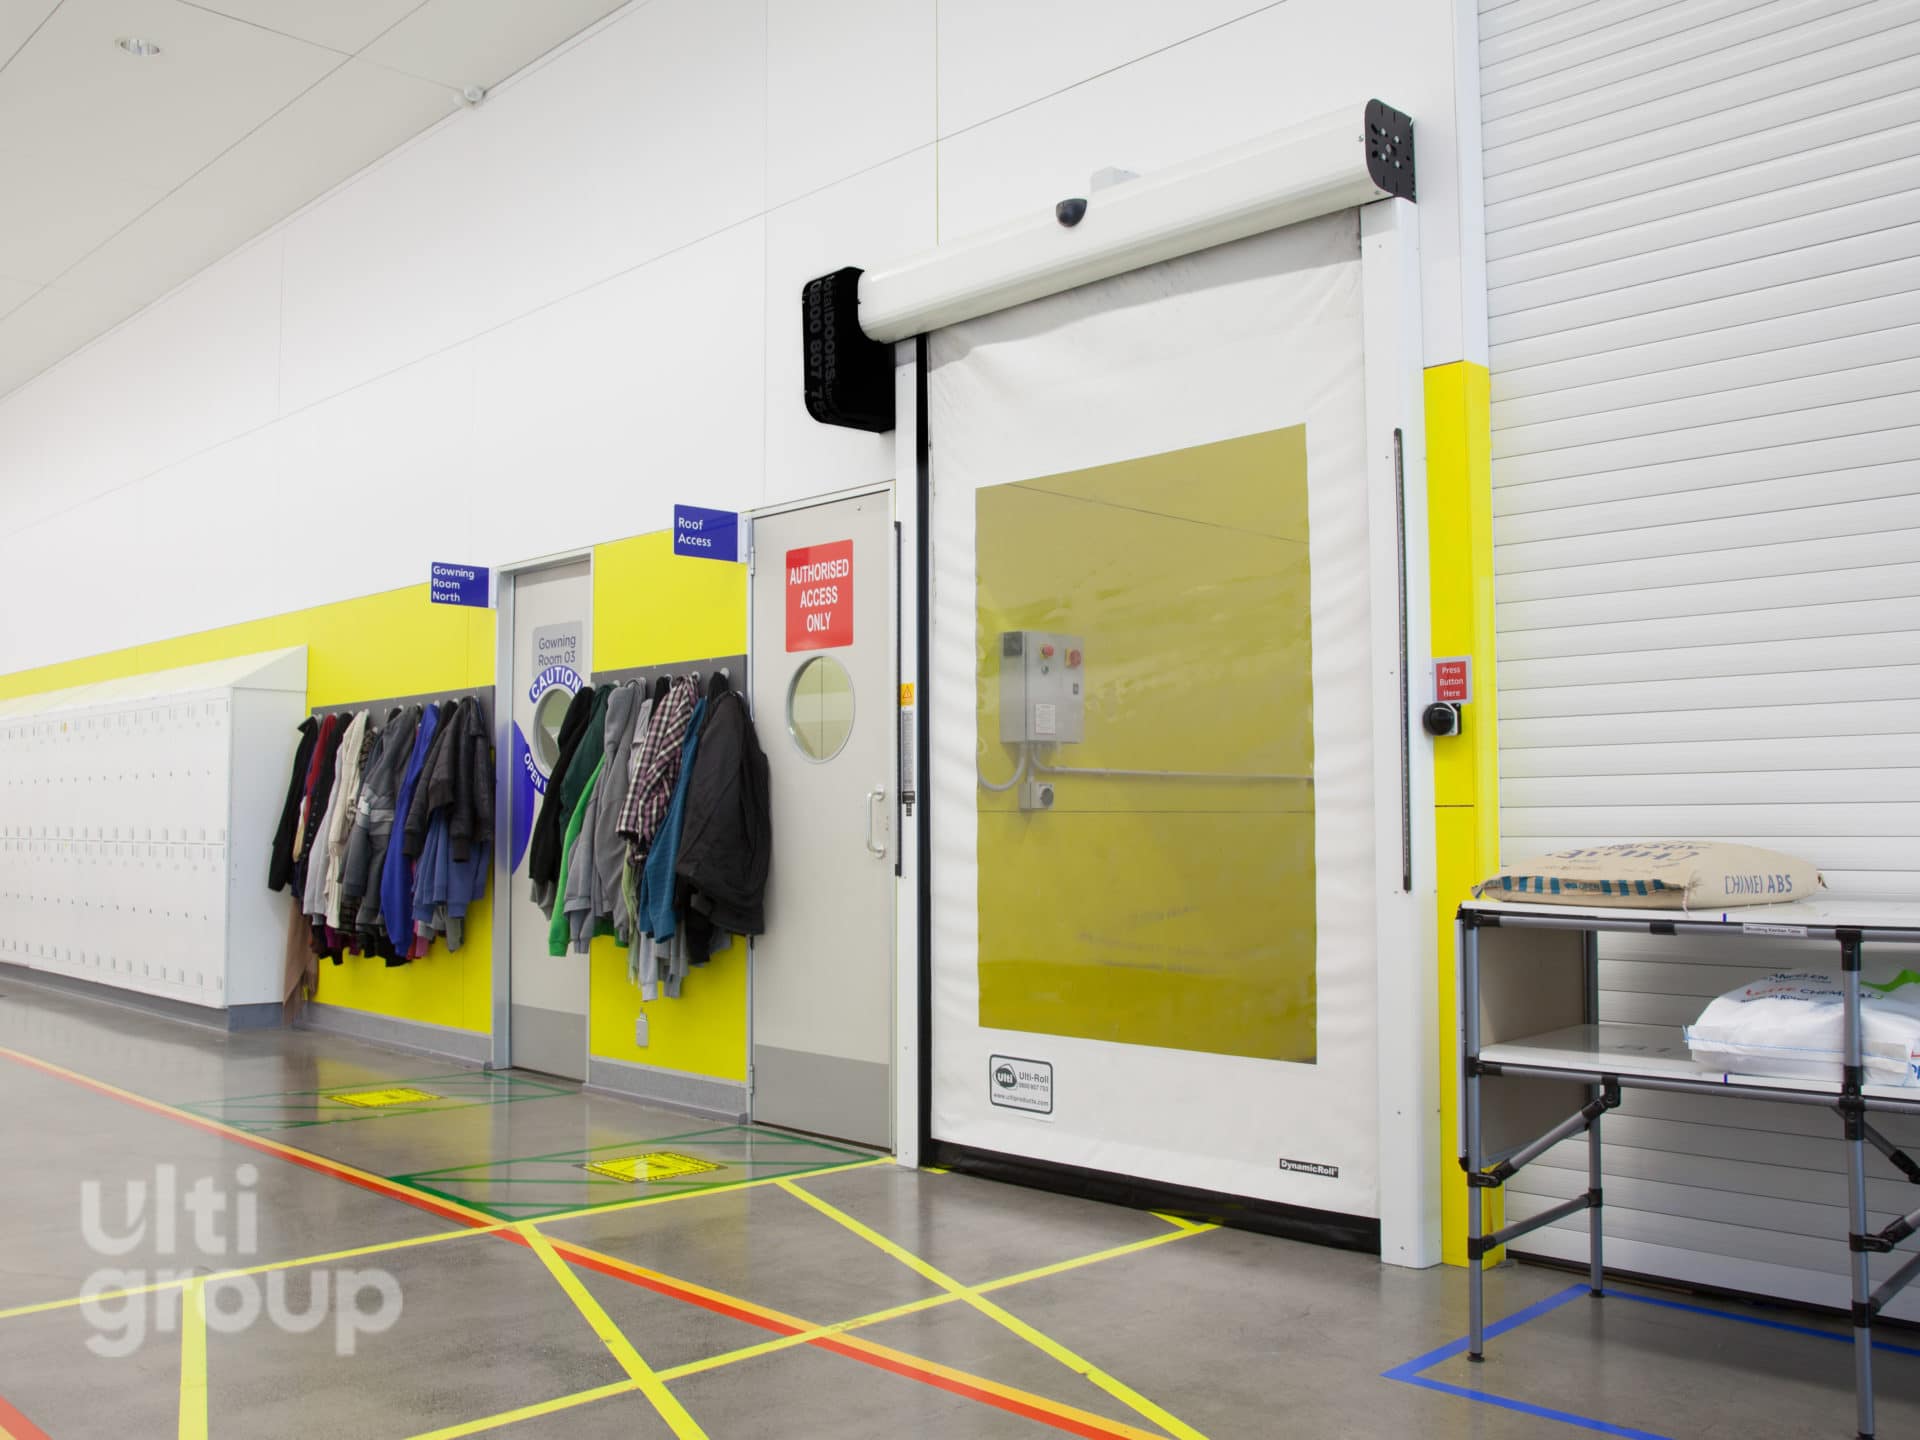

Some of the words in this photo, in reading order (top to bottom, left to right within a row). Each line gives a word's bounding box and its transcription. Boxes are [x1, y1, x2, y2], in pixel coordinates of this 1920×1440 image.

[809, 280, 823, 333] 0800
[810, 338, 823, 379] 807
[678, 517, 703, 530] Roof
[678, 533, 712, 547] Access
[433, 566, 475, 581] Gowning
[789, 559, 849, 585] AUTHORISED
[432, 578, 460, 590] Room
[432, 591, 461, 602] North
[800, 585, 838, 608] ACCESS
[806, 611, 832, 632] ONLY
[538, 634, 577, 650] Gowning
[538, 653, 562, 666] Room
[564, 650, 576, 664] 03
[1441, 666, 1460, 675] Press
[531, 666, 582, 699] CAUTION
[1440, 678, 1464, 686] Button
[524, 752, 543, 789] OPEN
[1767, 874, 1793, 893] ABS
[1018, 1071, 1049, 1085] Ulti-Roll
